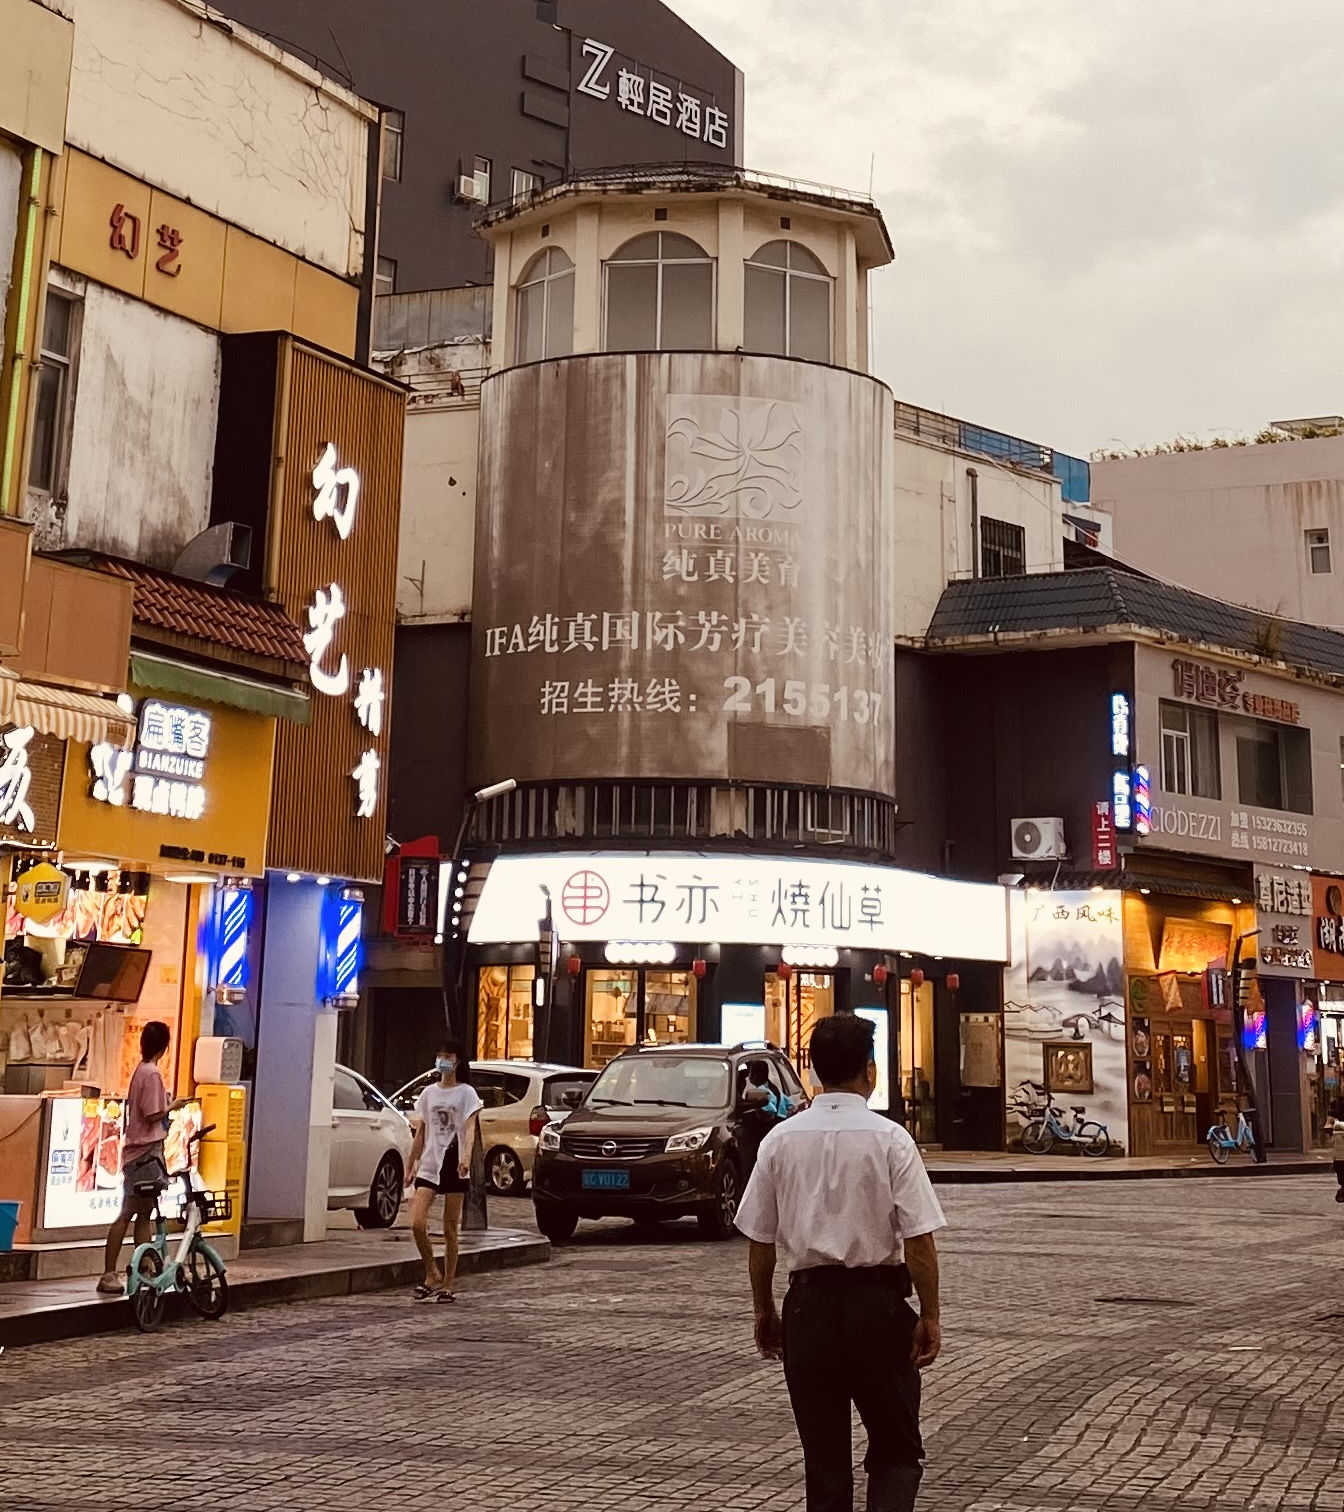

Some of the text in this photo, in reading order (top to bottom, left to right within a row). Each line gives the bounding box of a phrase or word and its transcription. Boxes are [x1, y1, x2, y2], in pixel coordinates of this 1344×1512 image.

[618, 68, 729, 149] 輕居酒店
[109, 202, 184, 278] 幻艺
[664, 522, 804, 548] PURE AROMA
[539, 675, 883, 729] 招生热线： 2155137
[621, 873, 885, 932] 书亦 燒仙草
[1033, 903, 1120, 925] 广西风味
